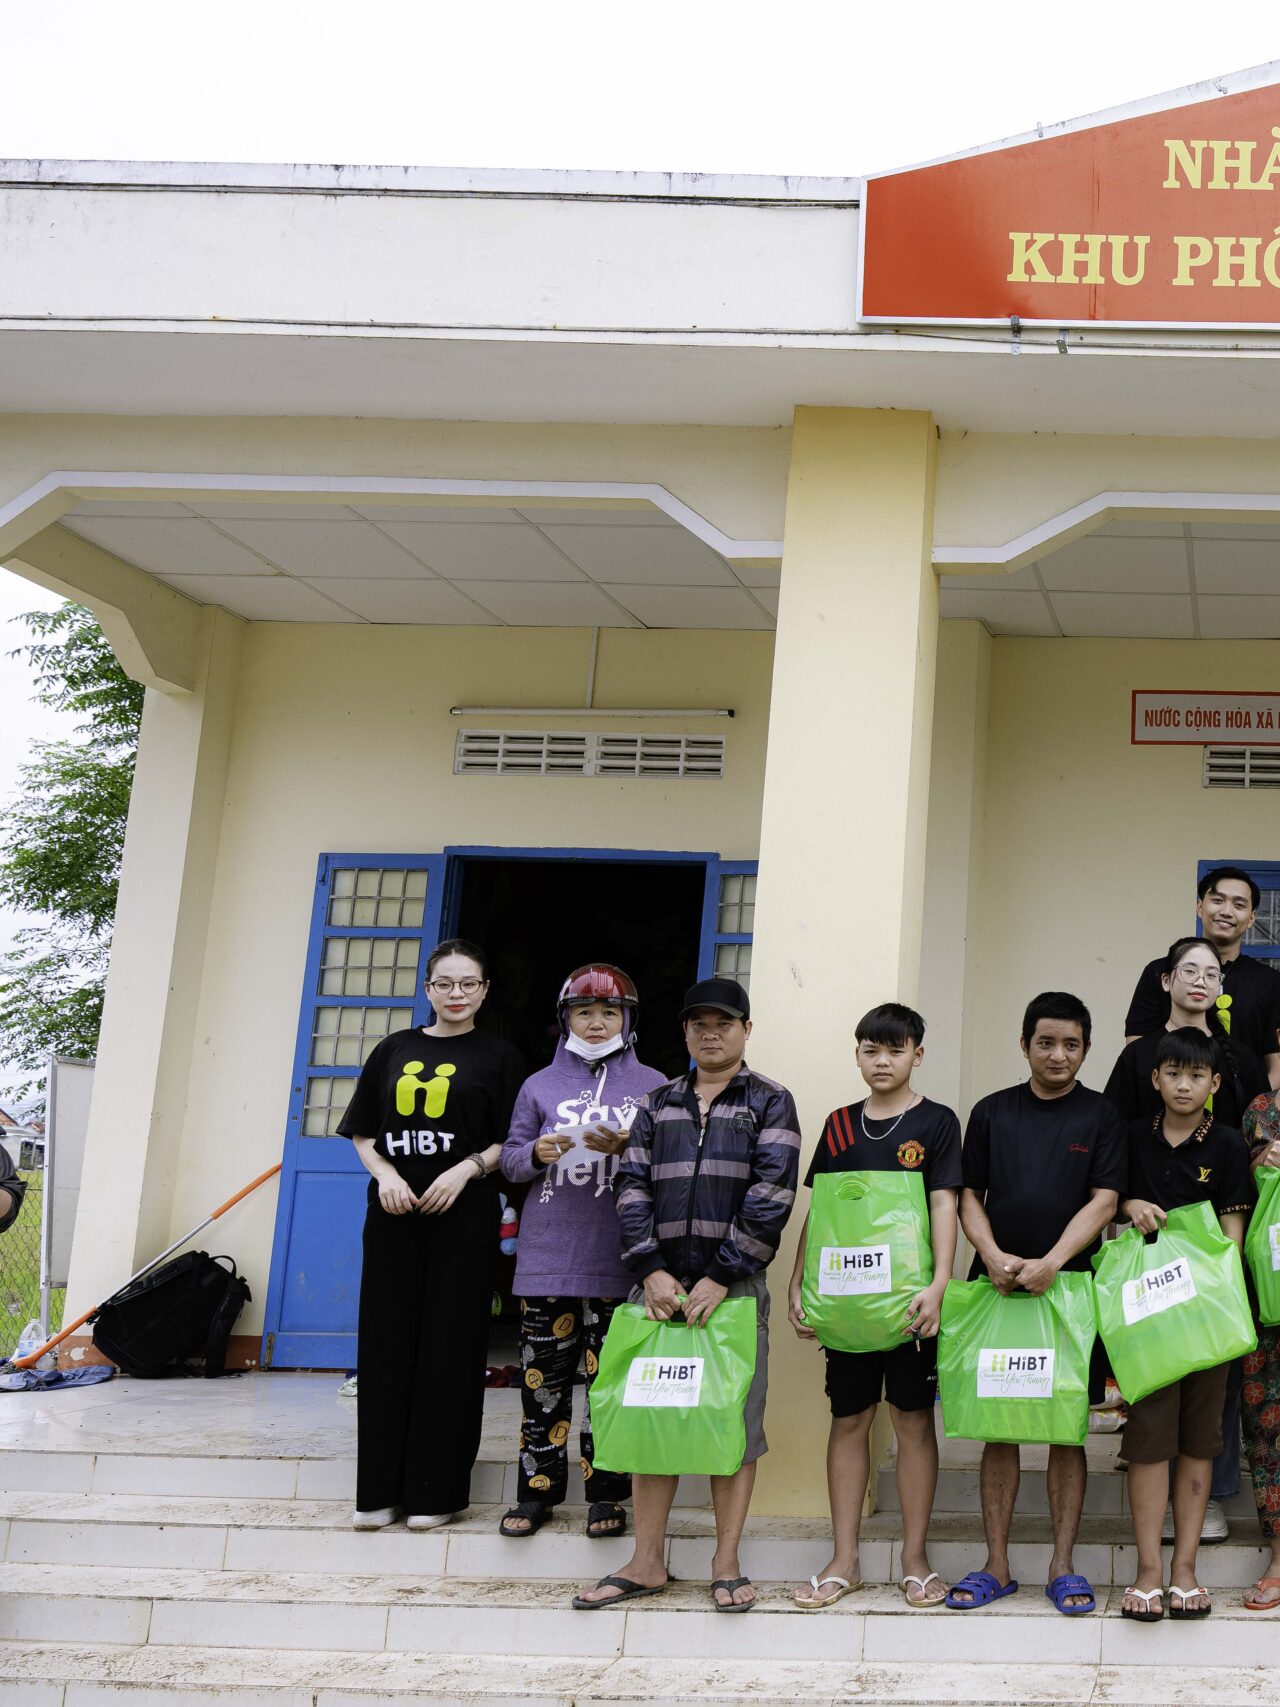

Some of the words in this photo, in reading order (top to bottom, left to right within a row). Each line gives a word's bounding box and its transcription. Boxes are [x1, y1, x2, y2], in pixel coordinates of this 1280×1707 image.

[1007, 232, 1151, 285] KHU
[1144, 706, 1181, 727] NƯỚC
[1185, 707, 1221, 731] CỘNG
[1225, 707, 1252, 729] HÒA
[1256, 708, 1273, 729] XÃ
[386, 1130, 455, 1157] HiBT
[844, 1252, 884, 1269] HiBT
[1146, 1265, 1182, 1290] HiBT
[658, 1365, 697, 1380] HiBT
[1008, 1356, 1048, 1371] HiBT
